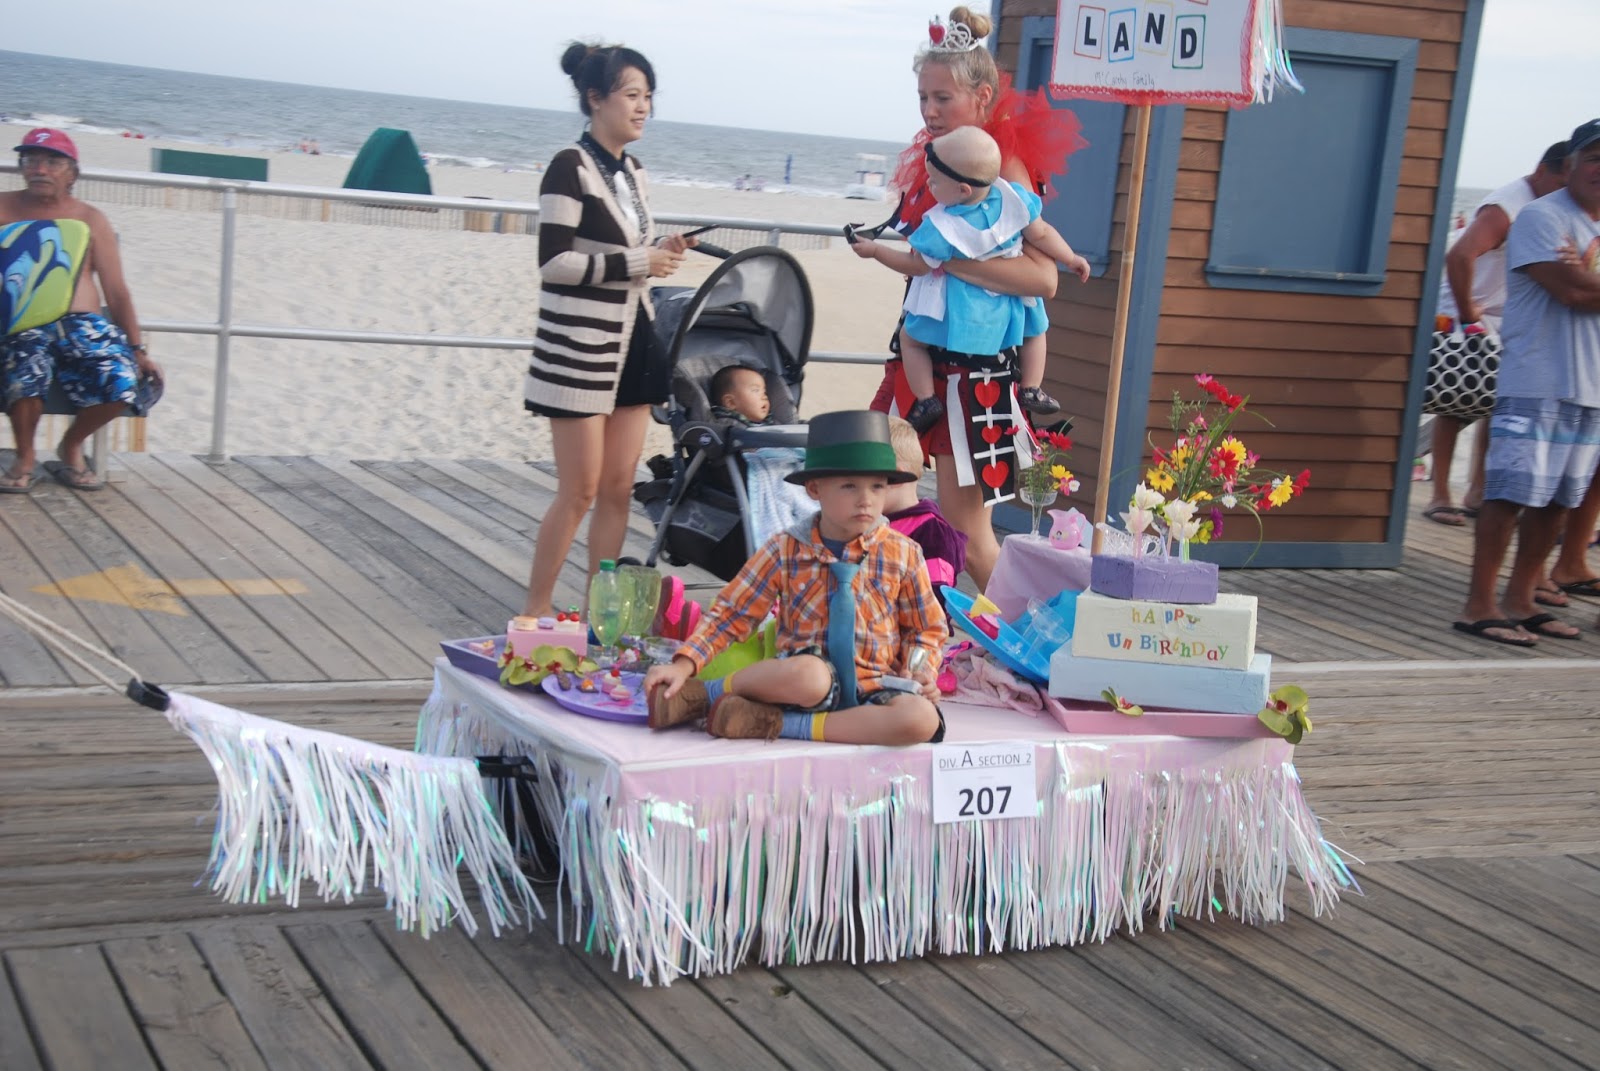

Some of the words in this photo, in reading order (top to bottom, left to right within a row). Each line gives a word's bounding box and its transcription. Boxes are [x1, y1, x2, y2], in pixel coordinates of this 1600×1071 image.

[1083, 12, 1198, 60] LAND
[1132, 71, 1155, 88] Family
[961, 750, 973, 767] A
[978, 754, 1020, 767] SECTION
[1026, 753, 1032, 764] 2
[958, 786, 1012, 816] 207
